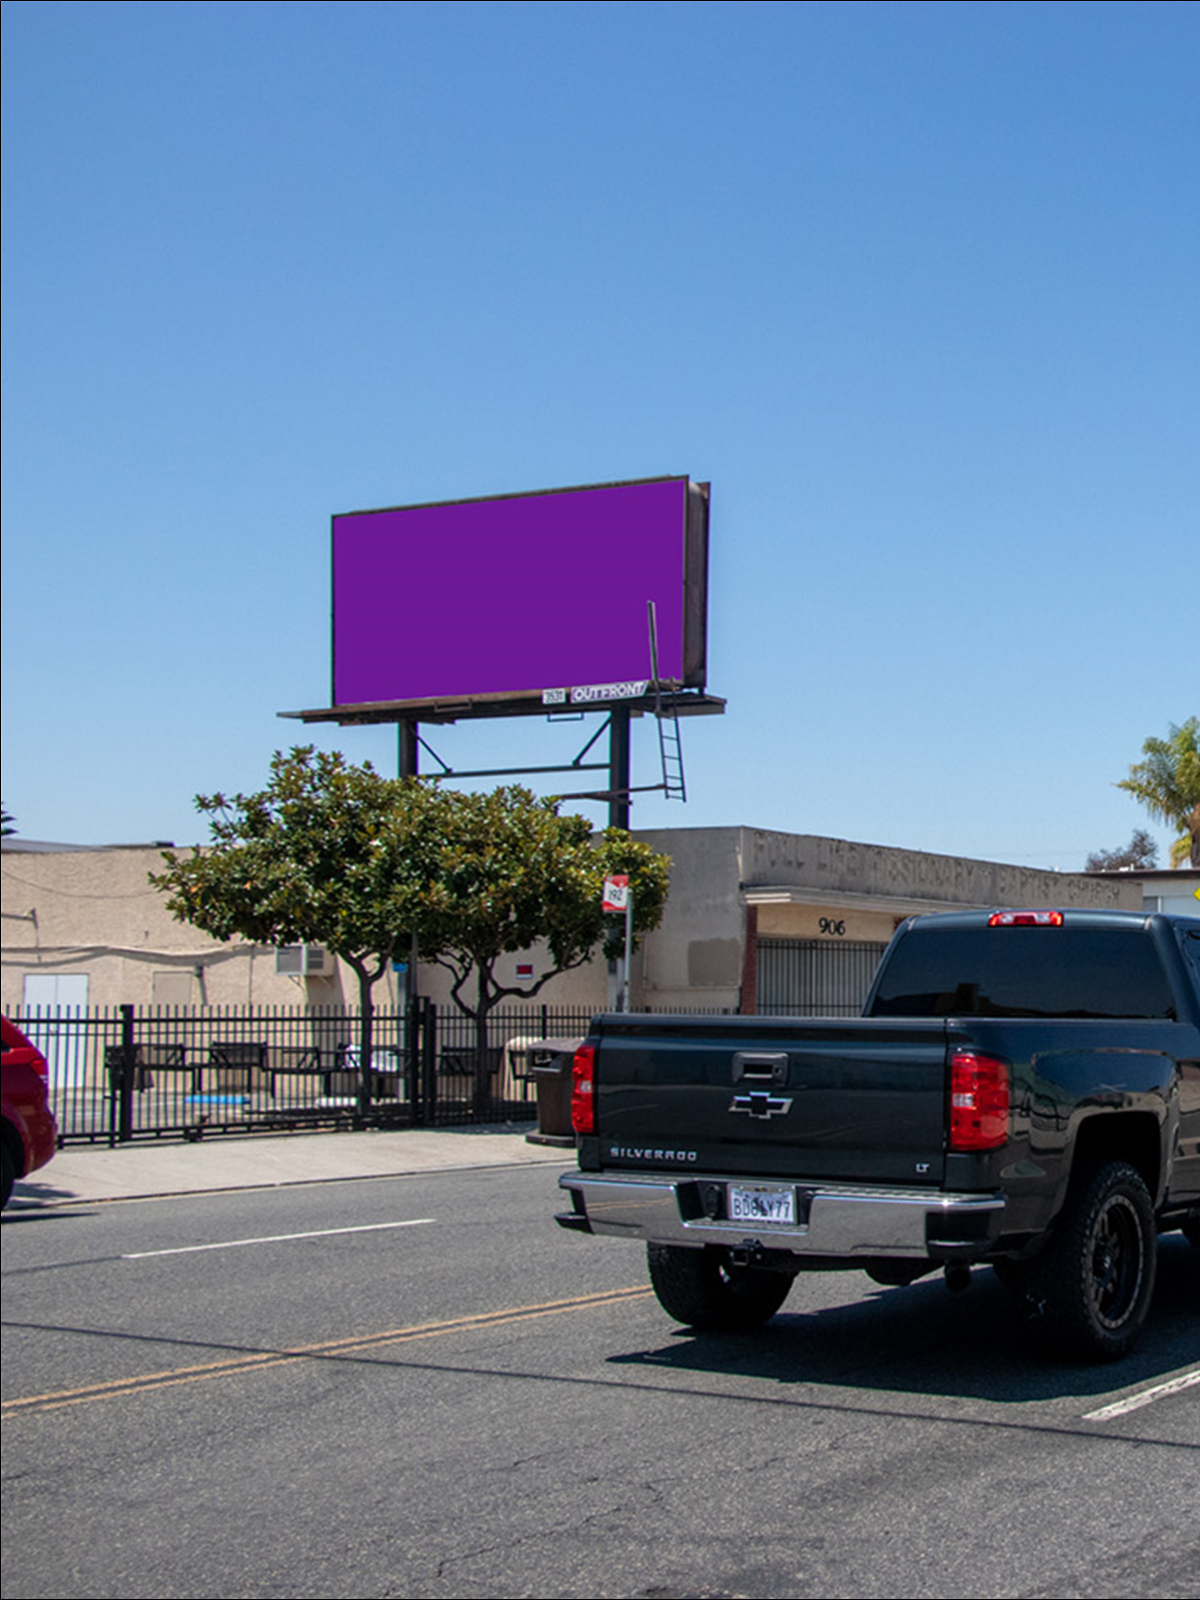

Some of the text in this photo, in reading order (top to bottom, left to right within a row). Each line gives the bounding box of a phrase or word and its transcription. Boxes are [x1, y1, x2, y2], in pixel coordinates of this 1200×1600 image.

[574, 682, 644, 701] OUTFRONT
[818, 916, 846, 936] 906
[609, 1147, 698, 1161] SILVERADO
[915, 1163, 930, 1173] LT
